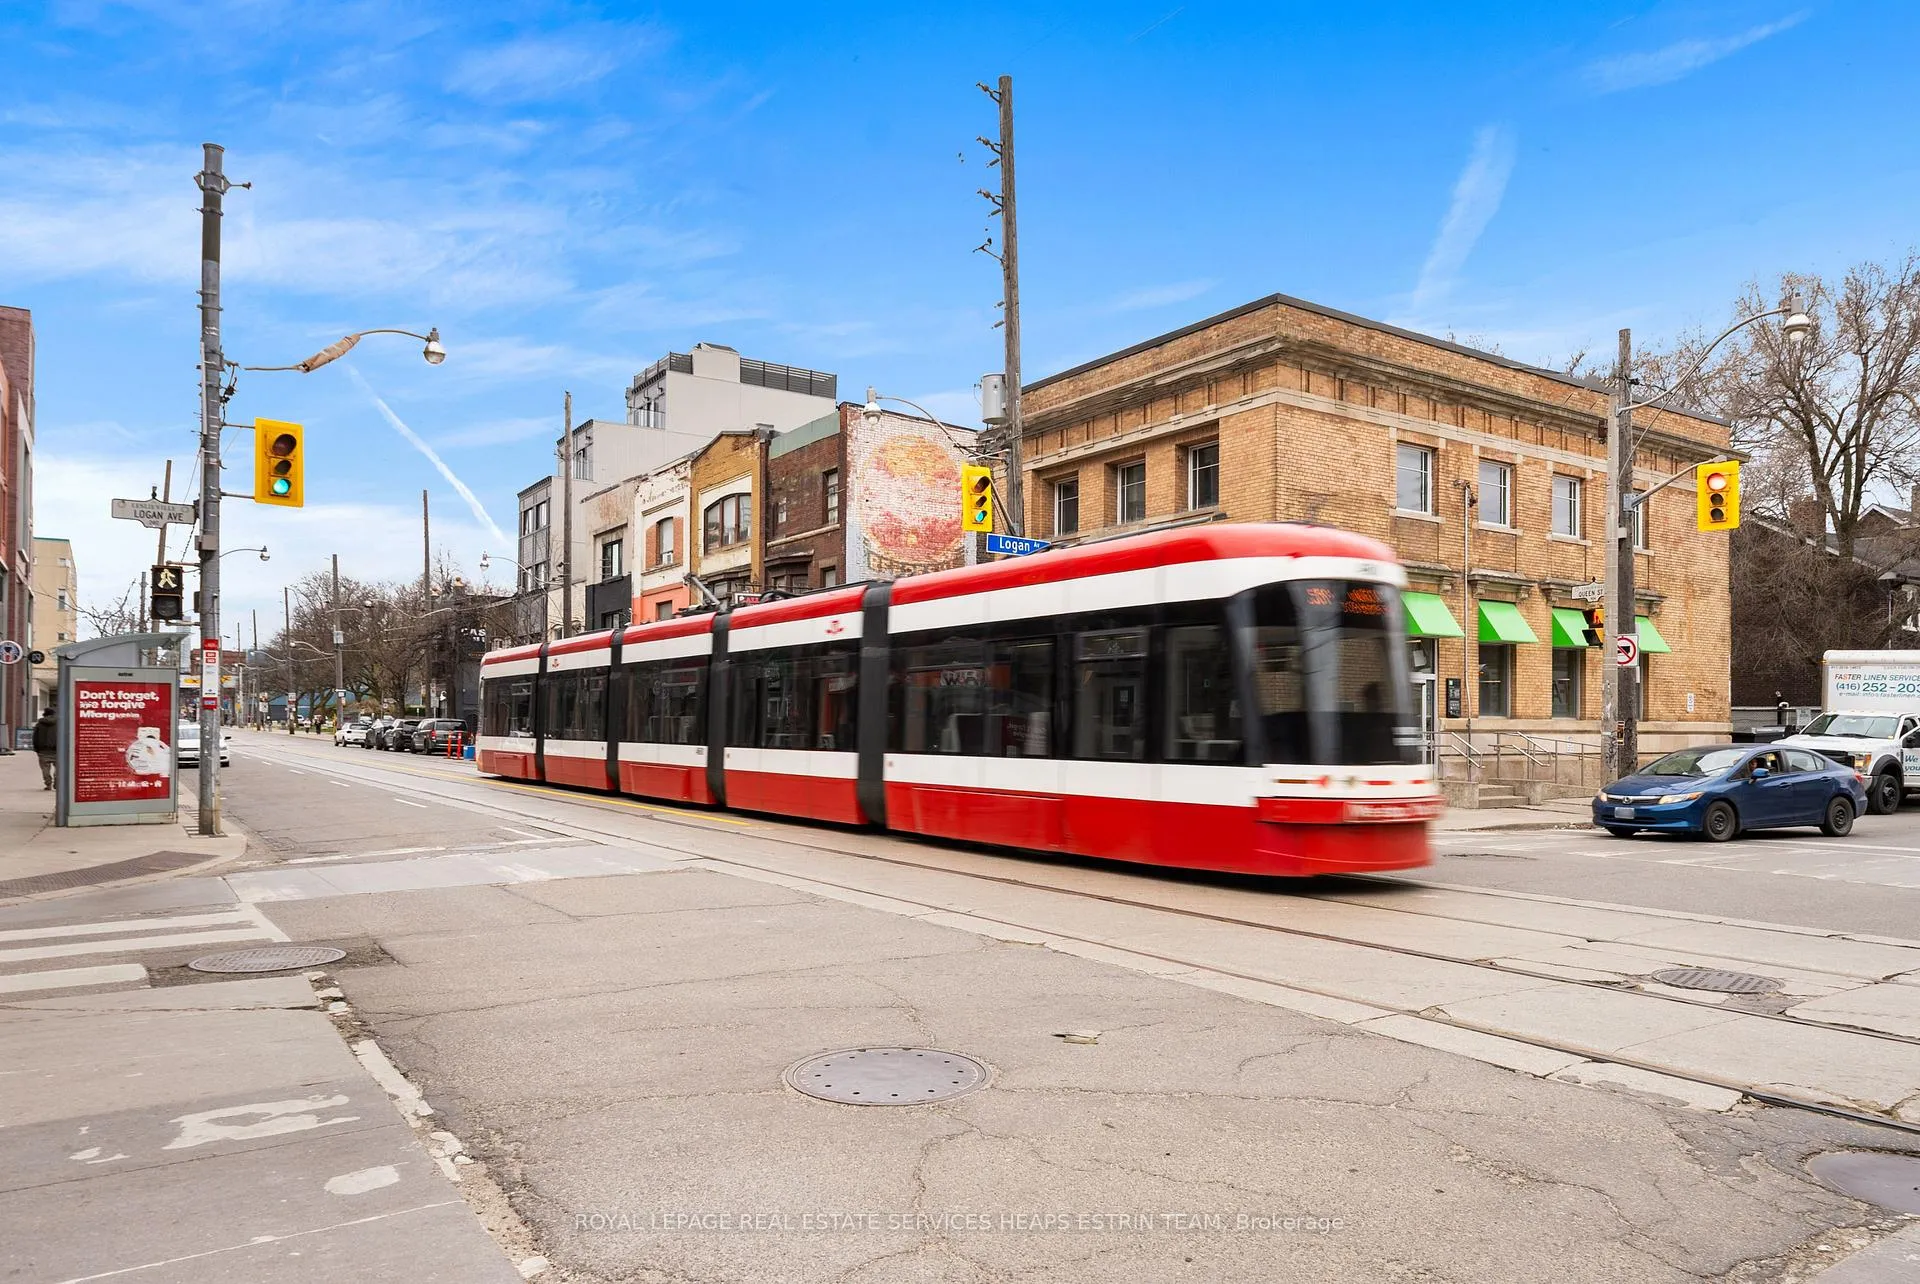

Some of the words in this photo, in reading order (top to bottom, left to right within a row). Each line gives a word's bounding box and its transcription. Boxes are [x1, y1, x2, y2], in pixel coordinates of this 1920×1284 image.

[133, 509, 164, 520] LOGAN
[167, 511, 184, 522] AVE
[999, 537, 1031, 554] Logan
[1578, 590, 1596, 598] QUEEN
[1834, 673, 1862, 681] FASTER
[1836, 682, 1861, 691] (416)
[80, 690, 116, 700] Don't
[117, 690, 160, 702] forget,
[101, 700, 146, 711] forgive
[1905, 754, 1918, 763] We
